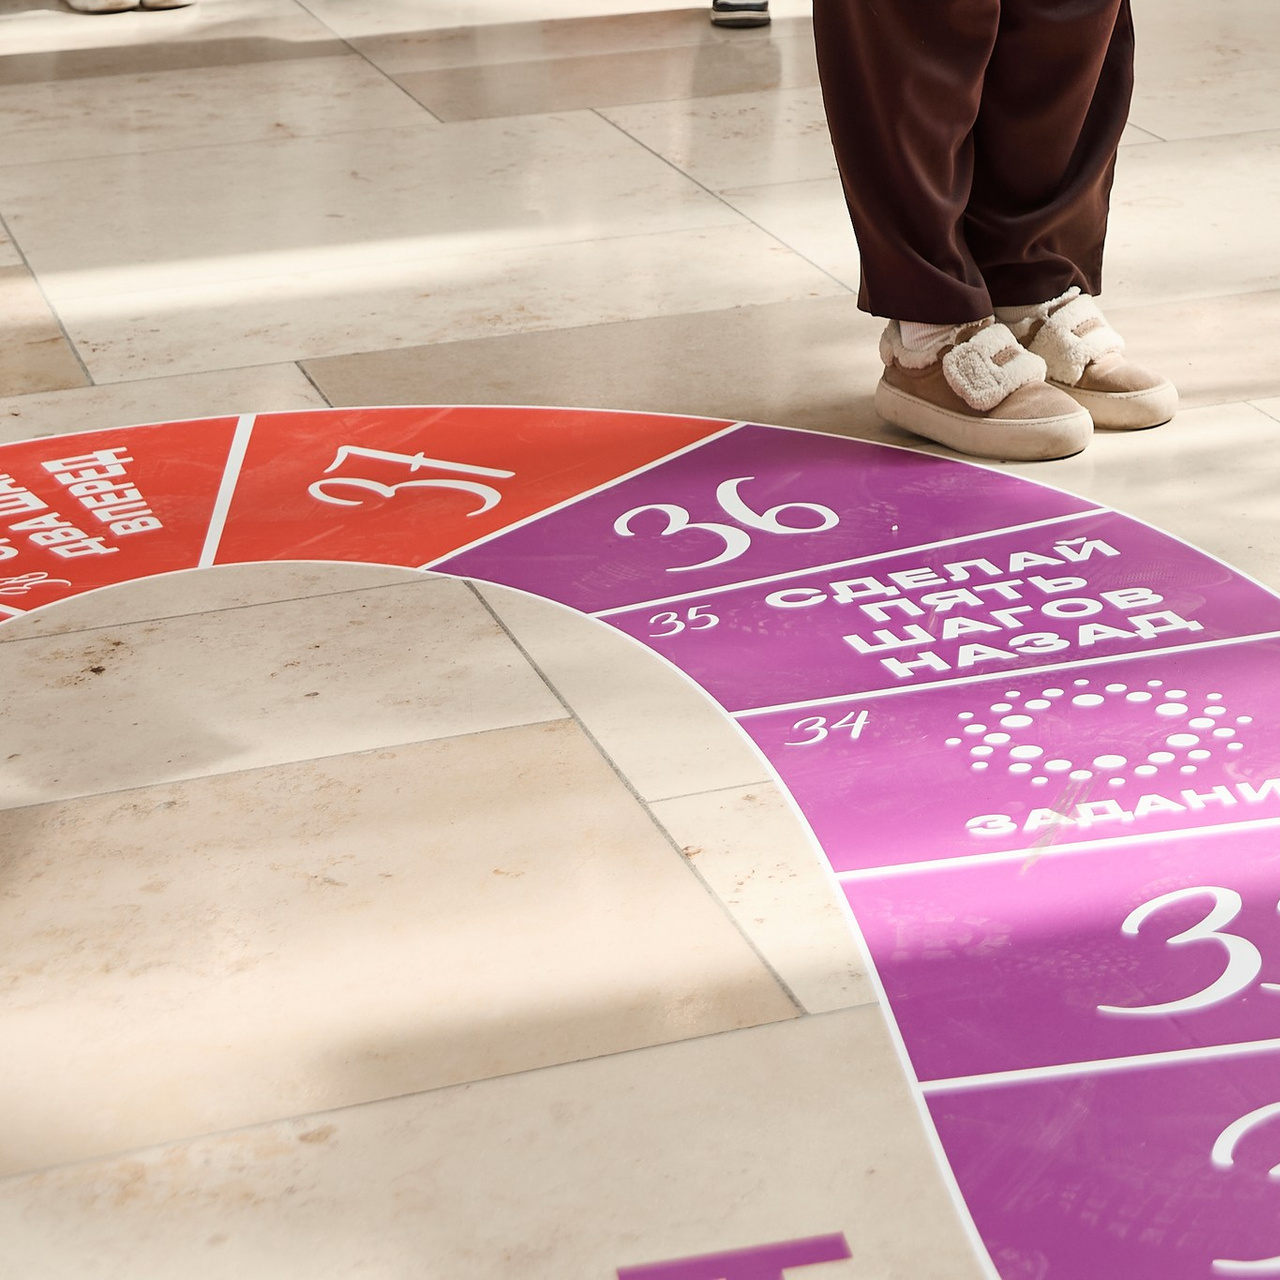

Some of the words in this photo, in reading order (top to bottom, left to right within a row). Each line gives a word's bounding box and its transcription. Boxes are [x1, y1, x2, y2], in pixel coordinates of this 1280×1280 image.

[40, 446, 163, 536] ВПЕРЕД
[307, 444, 516, 518] 37
[8, 511, 120, 559] ДВА
[612, 475, 841, 572] 36
[764, 535, 1121, 608] СДЕЛАЙ
[868, 574, 1089, 624] ПЯТЬ
[648, 604, 721, 638] 35
[842, 585, 1165, 653] ШАГОВ
[877, 608, 1203, 678] НАЗАД
[783, 710, 871, 746] 34
